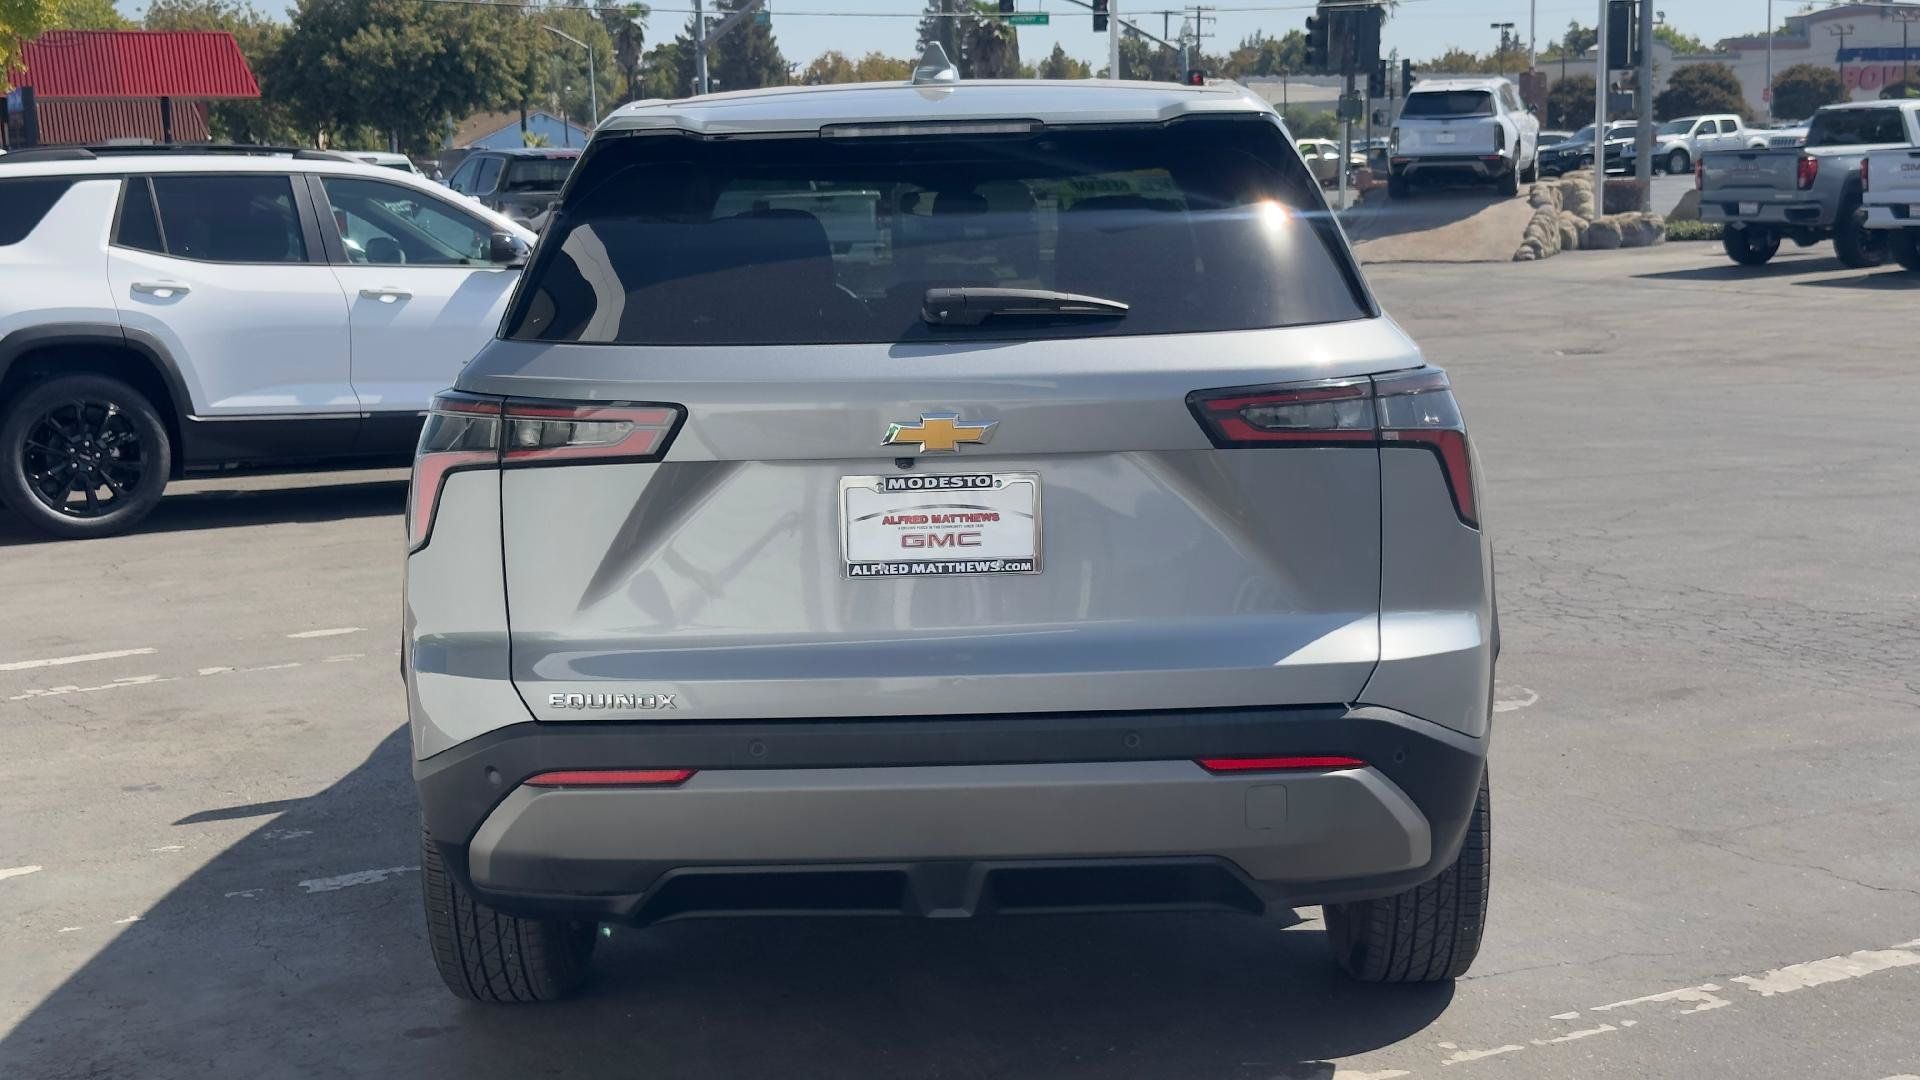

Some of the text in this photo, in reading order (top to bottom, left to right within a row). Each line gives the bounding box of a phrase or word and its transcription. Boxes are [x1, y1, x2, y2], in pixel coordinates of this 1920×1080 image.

[888, 476, 991, 490] MODESTO
[882, 512, 1000, 525] ALFRED MATTHEWS
[901, 531, 982, 549] GMC
[851, 563, 909, 576] ALFRED
[548, 693, 678, 710] EQUINOX
